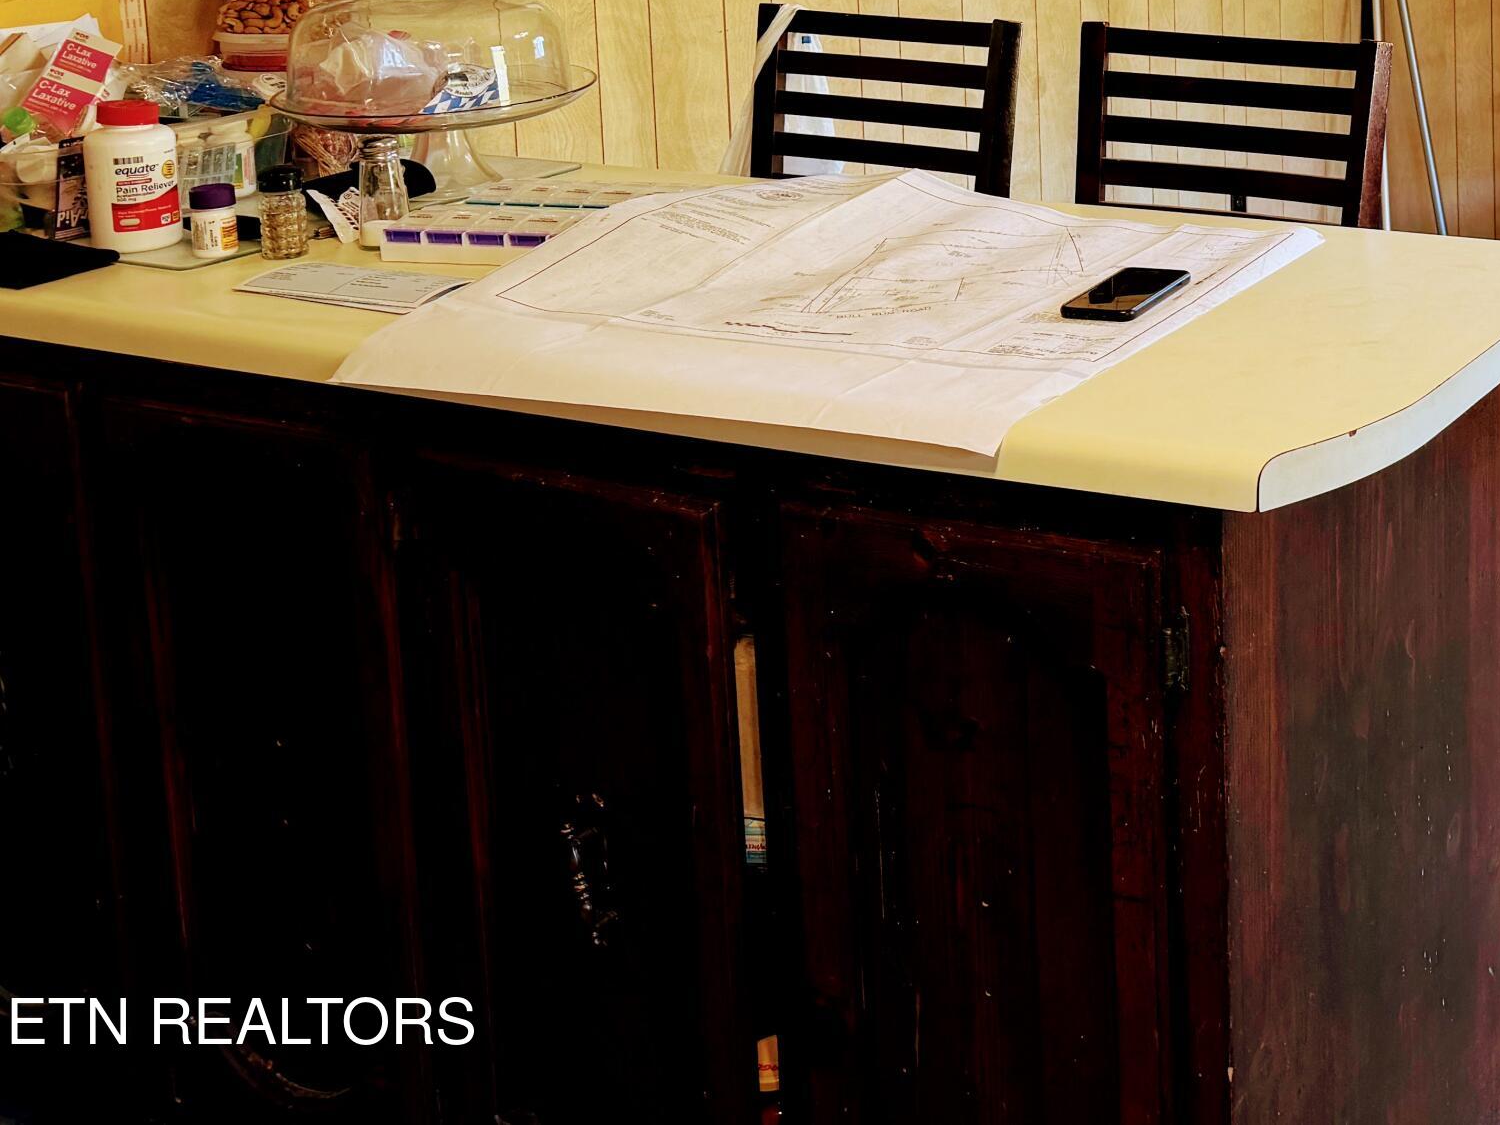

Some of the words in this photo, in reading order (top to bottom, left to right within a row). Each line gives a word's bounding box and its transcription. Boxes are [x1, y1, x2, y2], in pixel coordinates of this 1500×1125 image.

[66, 43, 92, 57] C-Lax
[62, 51, 97, 69] Laxative
[39, 80, 71, 97] C-Lax
[32, 88, 77, 110] Laxative
[115, 164, 156, 177] equate
[116, 186, 138, 194] Pain
[141, 180, 174, 192] Reliever
